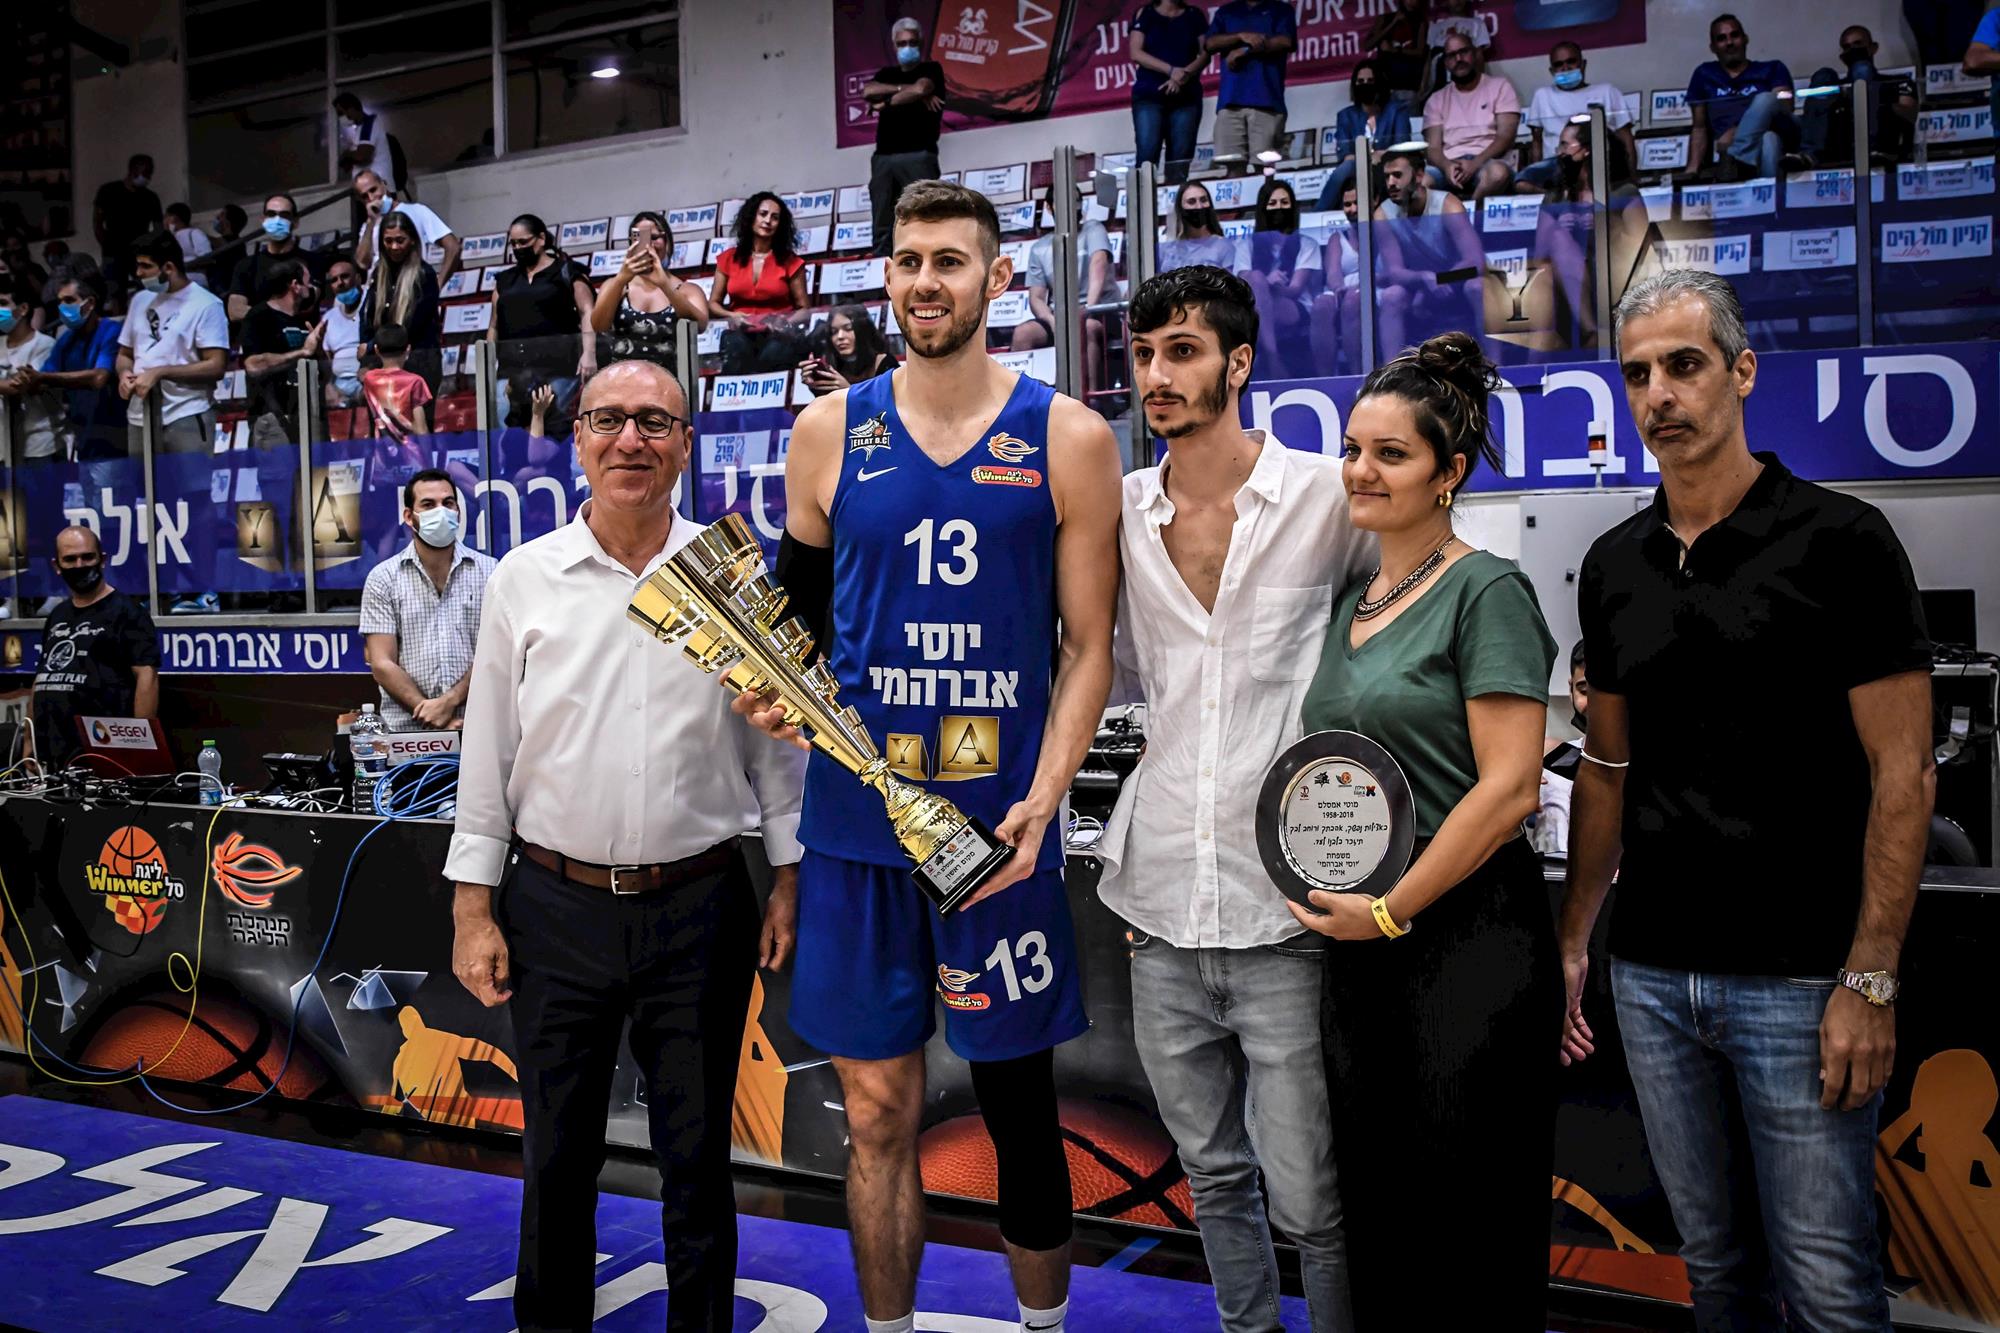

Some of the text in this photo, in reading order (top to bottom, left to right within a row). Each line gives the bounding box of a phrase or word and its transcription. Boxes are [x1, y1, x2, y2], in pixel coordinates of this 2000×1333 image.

[1948, 113, 1971, 129] מול
[1886, 223, 1989, 248] קניון מול הים
[1684, 244, 1709, 263] מול
[1714, 241, 1747, 263] קניון
[716, 377, 785, 399] קניון מול הים
[979, 471, 1022, 484] Winner
[904, 518, 979, 586] 13
[163, 632, 348, 670] יוסי אברהמי
[904, 622, 982, 661] יוסי
[868, 666, 1019, 708] אברהמי
[109, 724, 147, 738] SEGEV
[391, 740, 453, 753] SEGEV
[890, 737, 917, 764] Y
[947, 722, 992, 765] A
[1317, 801, 1343, 809] אמסלם
[944, 851, 976, 881] מקום ראשון
[1326, 852, 1351, 860] משפחת
[85, 864, 164, 896] Winner
[134, 861, 163, 880] ליגת
[1329, 868, 1346, 877] אילת
[164, 877, 185, 899] סל
[227, 911, 291, 932] מנהלת
[233, 928, 289, 947] הליגה
[984, 930, 1054, 1002] 13
